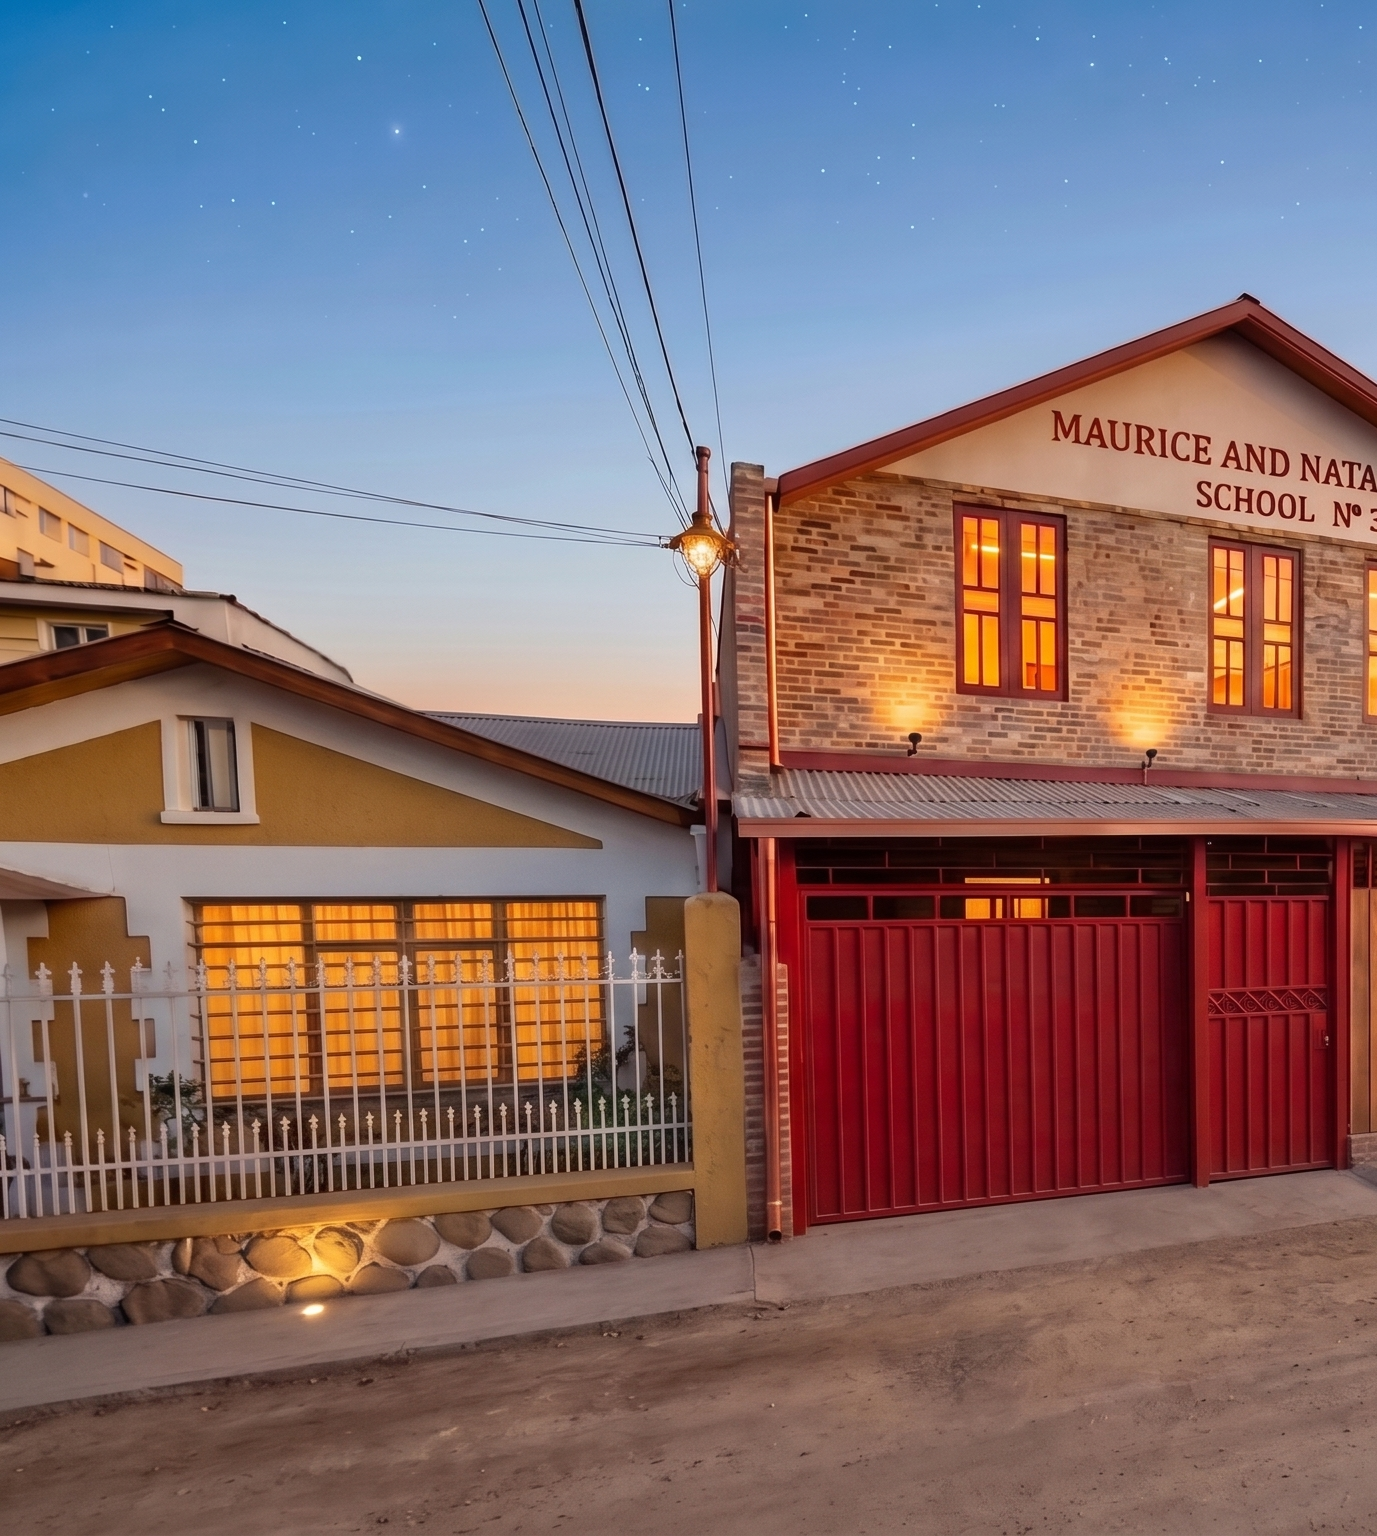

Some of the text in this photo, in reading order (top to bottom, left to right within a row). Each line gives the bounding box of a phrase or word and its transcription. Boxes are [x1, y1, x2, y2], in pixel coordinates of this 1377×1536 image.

[1051, 410, 1213, 466] MAURICE
[1220, 440, 1291, 478] AND
[1196, 480, 1316, 523] SCHOOL
